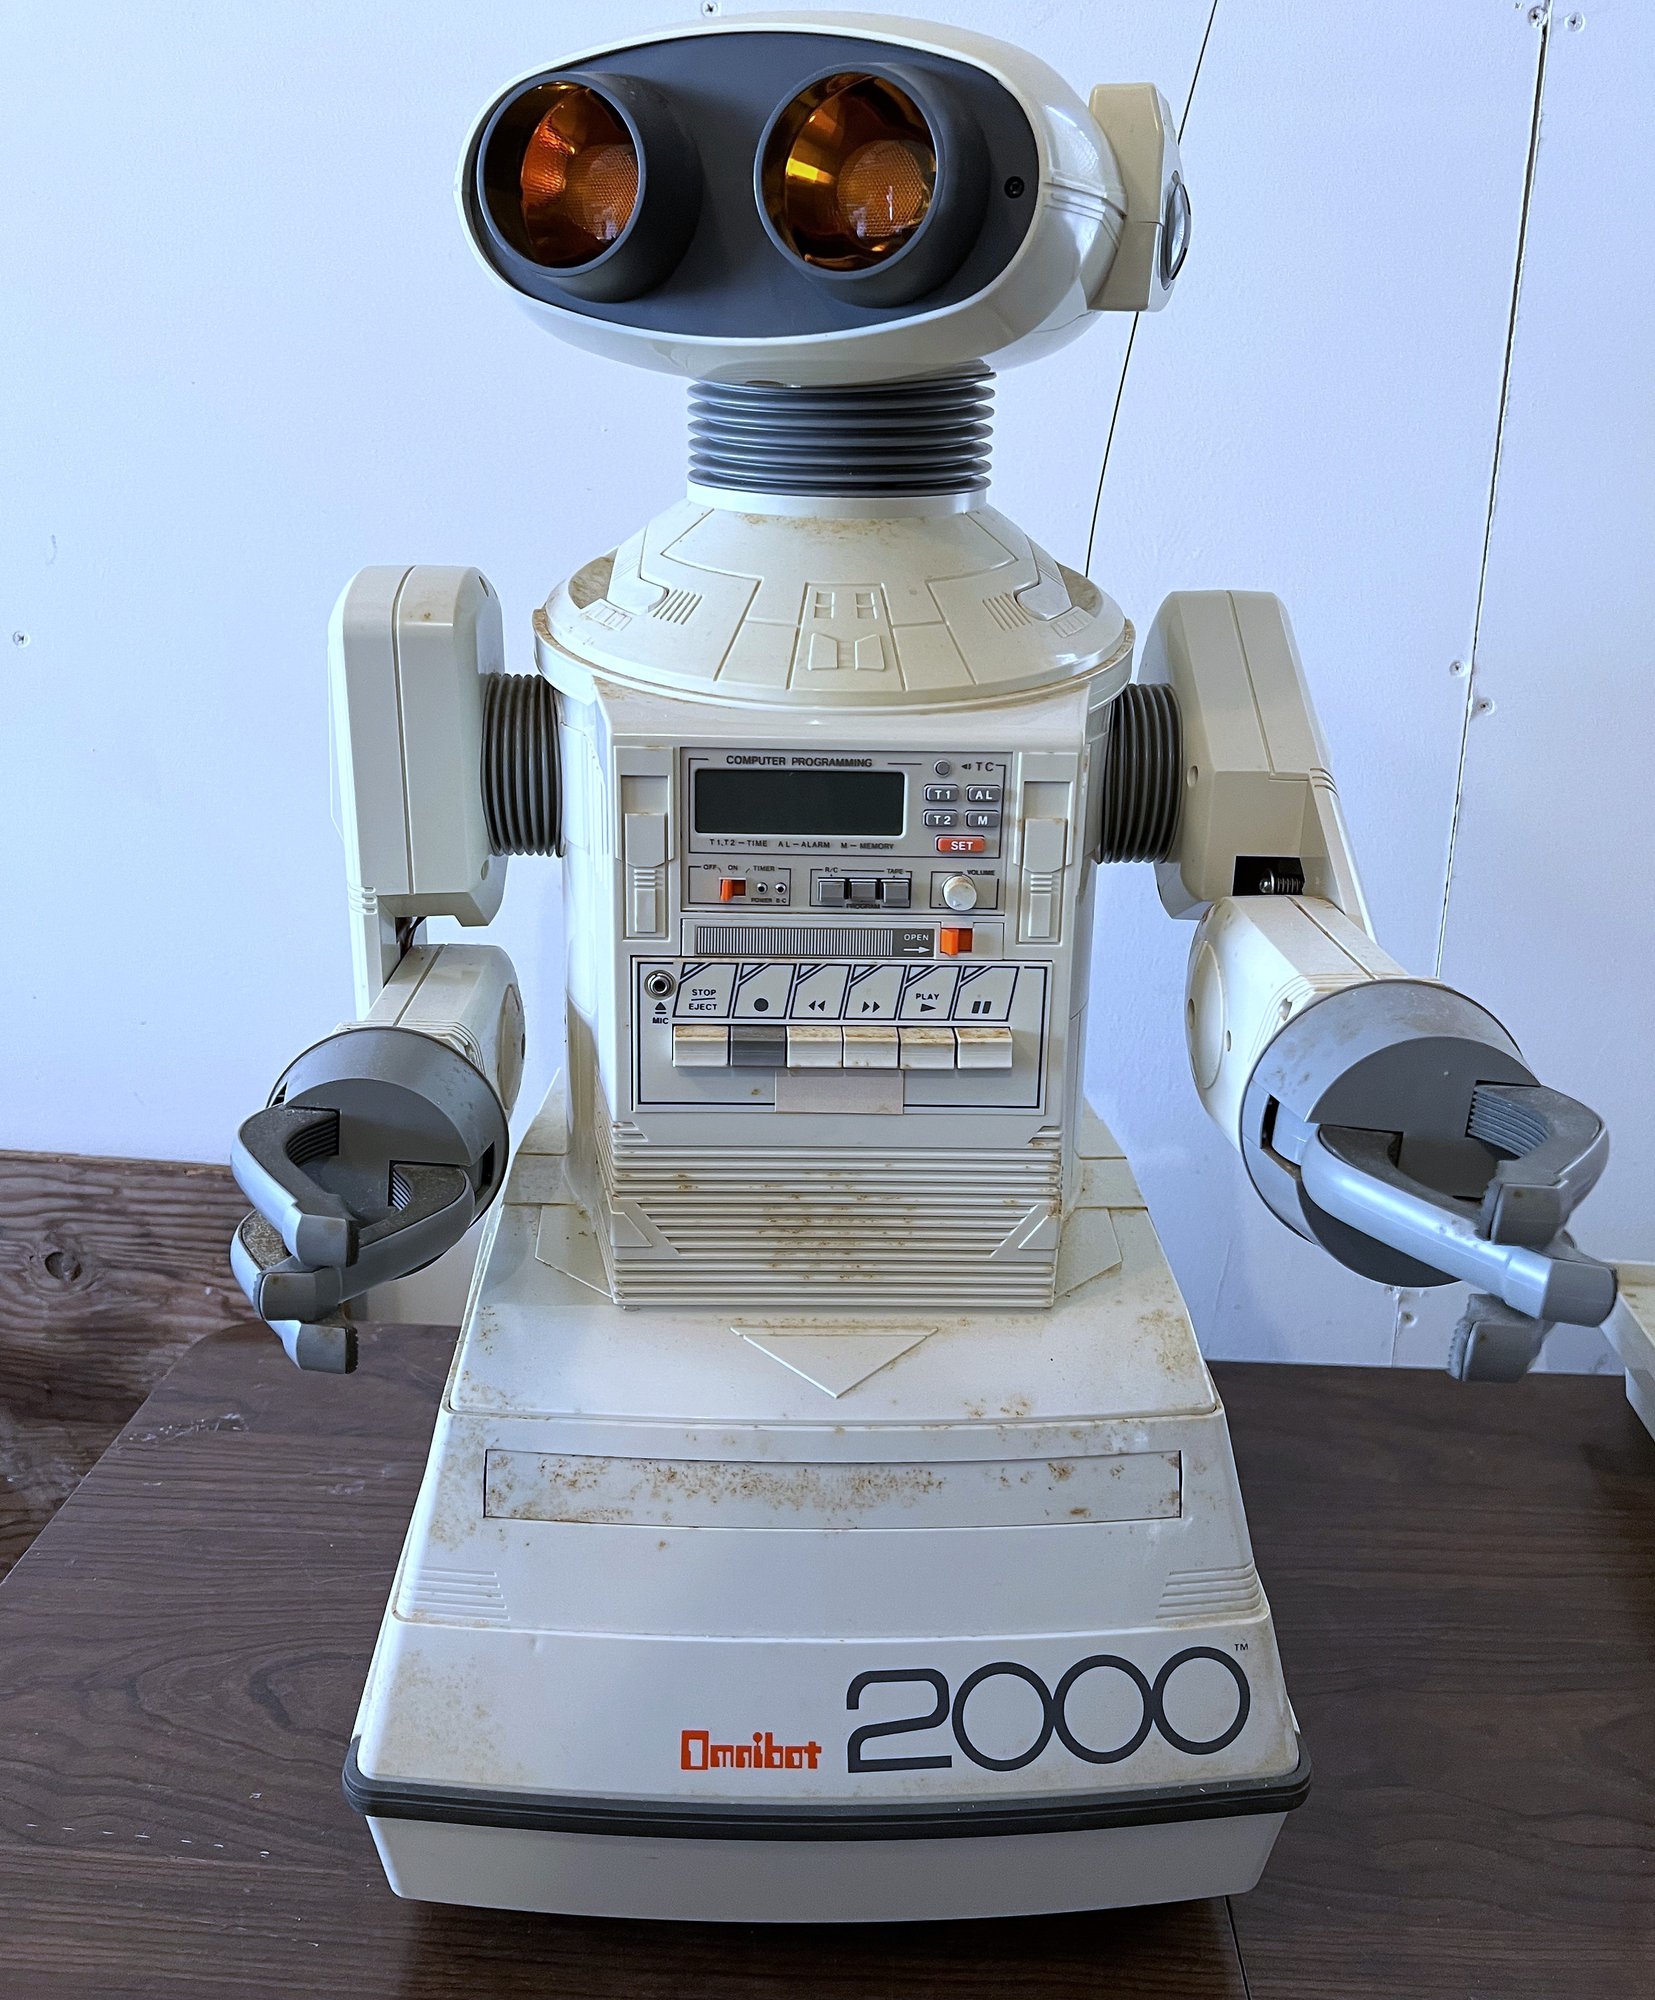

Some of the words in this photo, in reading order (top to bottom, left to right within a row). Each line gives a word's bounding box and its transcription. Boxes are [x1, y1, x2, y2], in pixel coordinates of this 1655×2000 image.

[726, 755, 786, 766] COMPUTER
[791, 757, 873, 768] PROGRAMMING
[975, 790, 993, 800] AL
[977, 815, 988, 825] M
[951, 841, 974, 851] SET
[903, 933, 929, 941] OPEN
[691, 988, 717, 997] STOP
[915, 992, 940, 1001] PLAY
[688, 1002, 718, 1011] EJECT
[652, 1017, 669, 1025] MIC
[681, 1730, 822, 1770] Omnibot
[846, 1646, 1251, 1774] 2000
